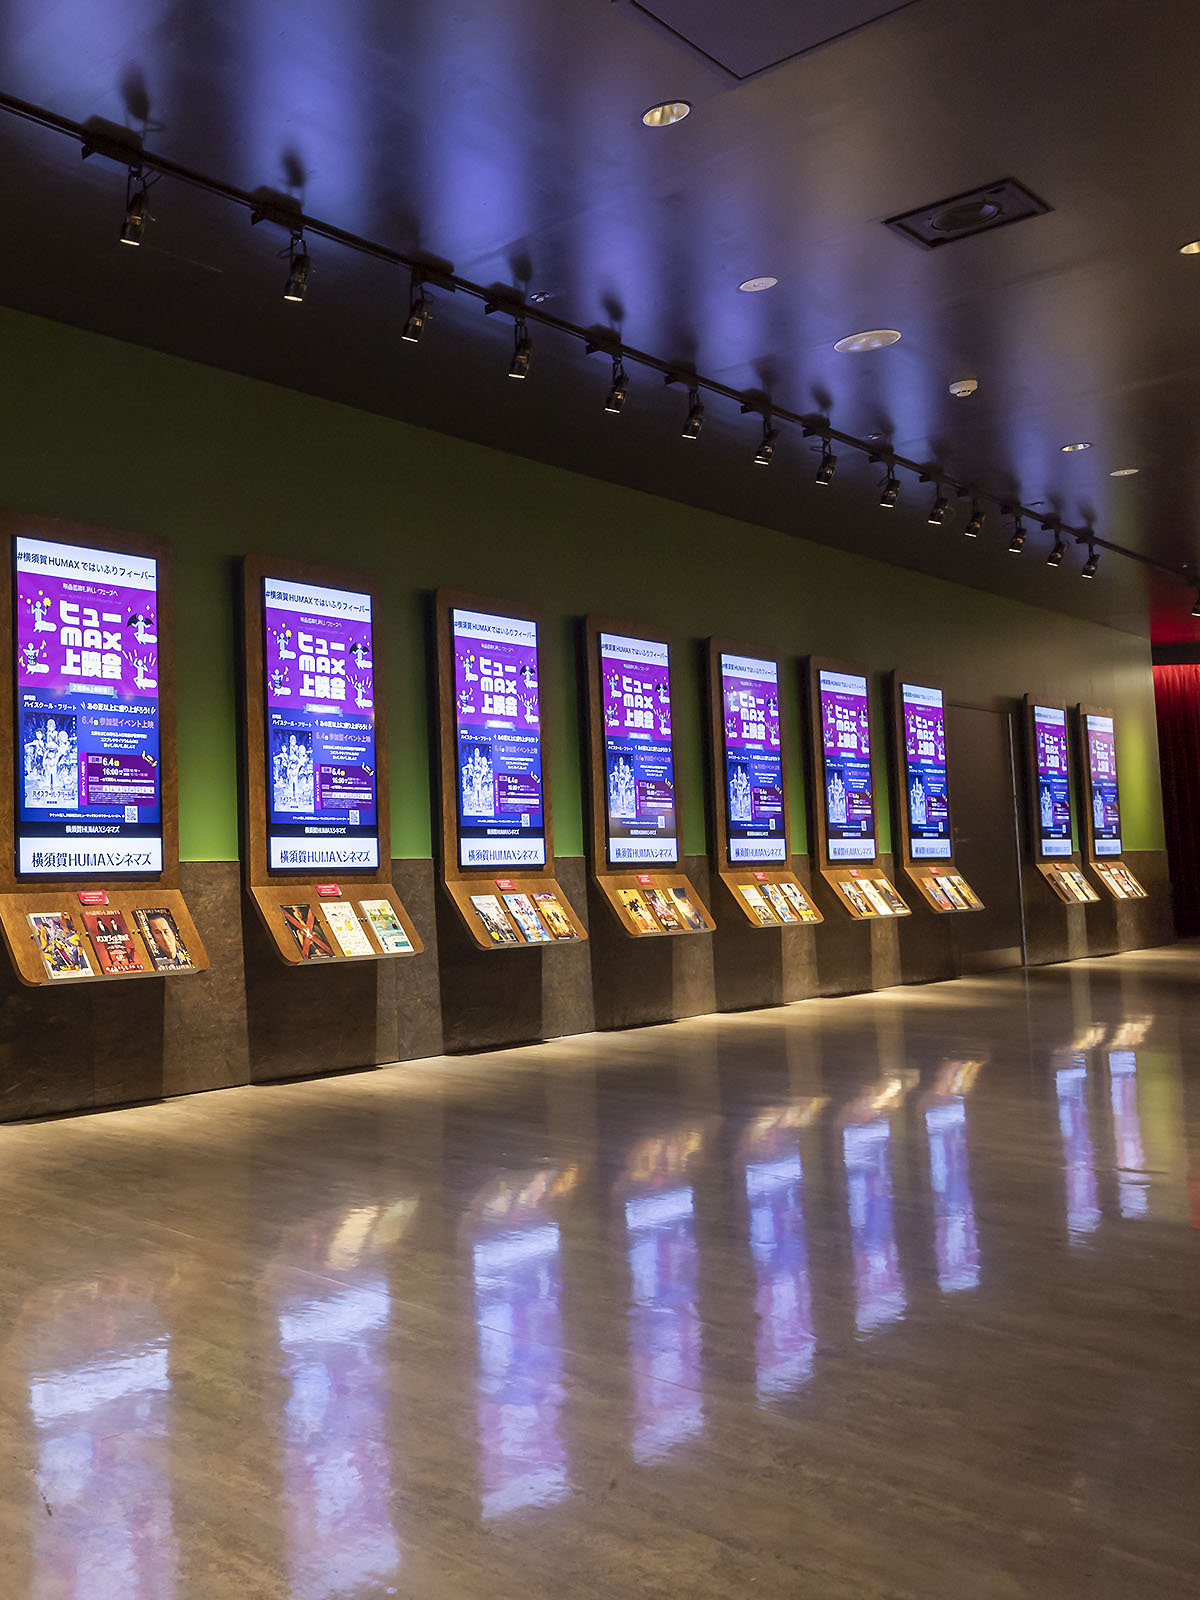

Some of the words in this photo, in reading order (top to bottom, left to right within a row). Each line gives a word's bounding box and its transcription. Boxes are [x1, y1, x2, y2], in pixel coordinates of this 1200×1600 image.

[59, 600, 122, 627] ヒュー
[60, 626, 122, 651] MAX
[298, 631, 346, 655] ヒュー
[60, 648, 122, 680] 上映会
[479, 656, 517, 677] ヒュー
[32, 852, 152, 868] 横須賀HUMAXシネマズ
[280, 850, 370, 863] 横須賀HUMAXシネマズ
